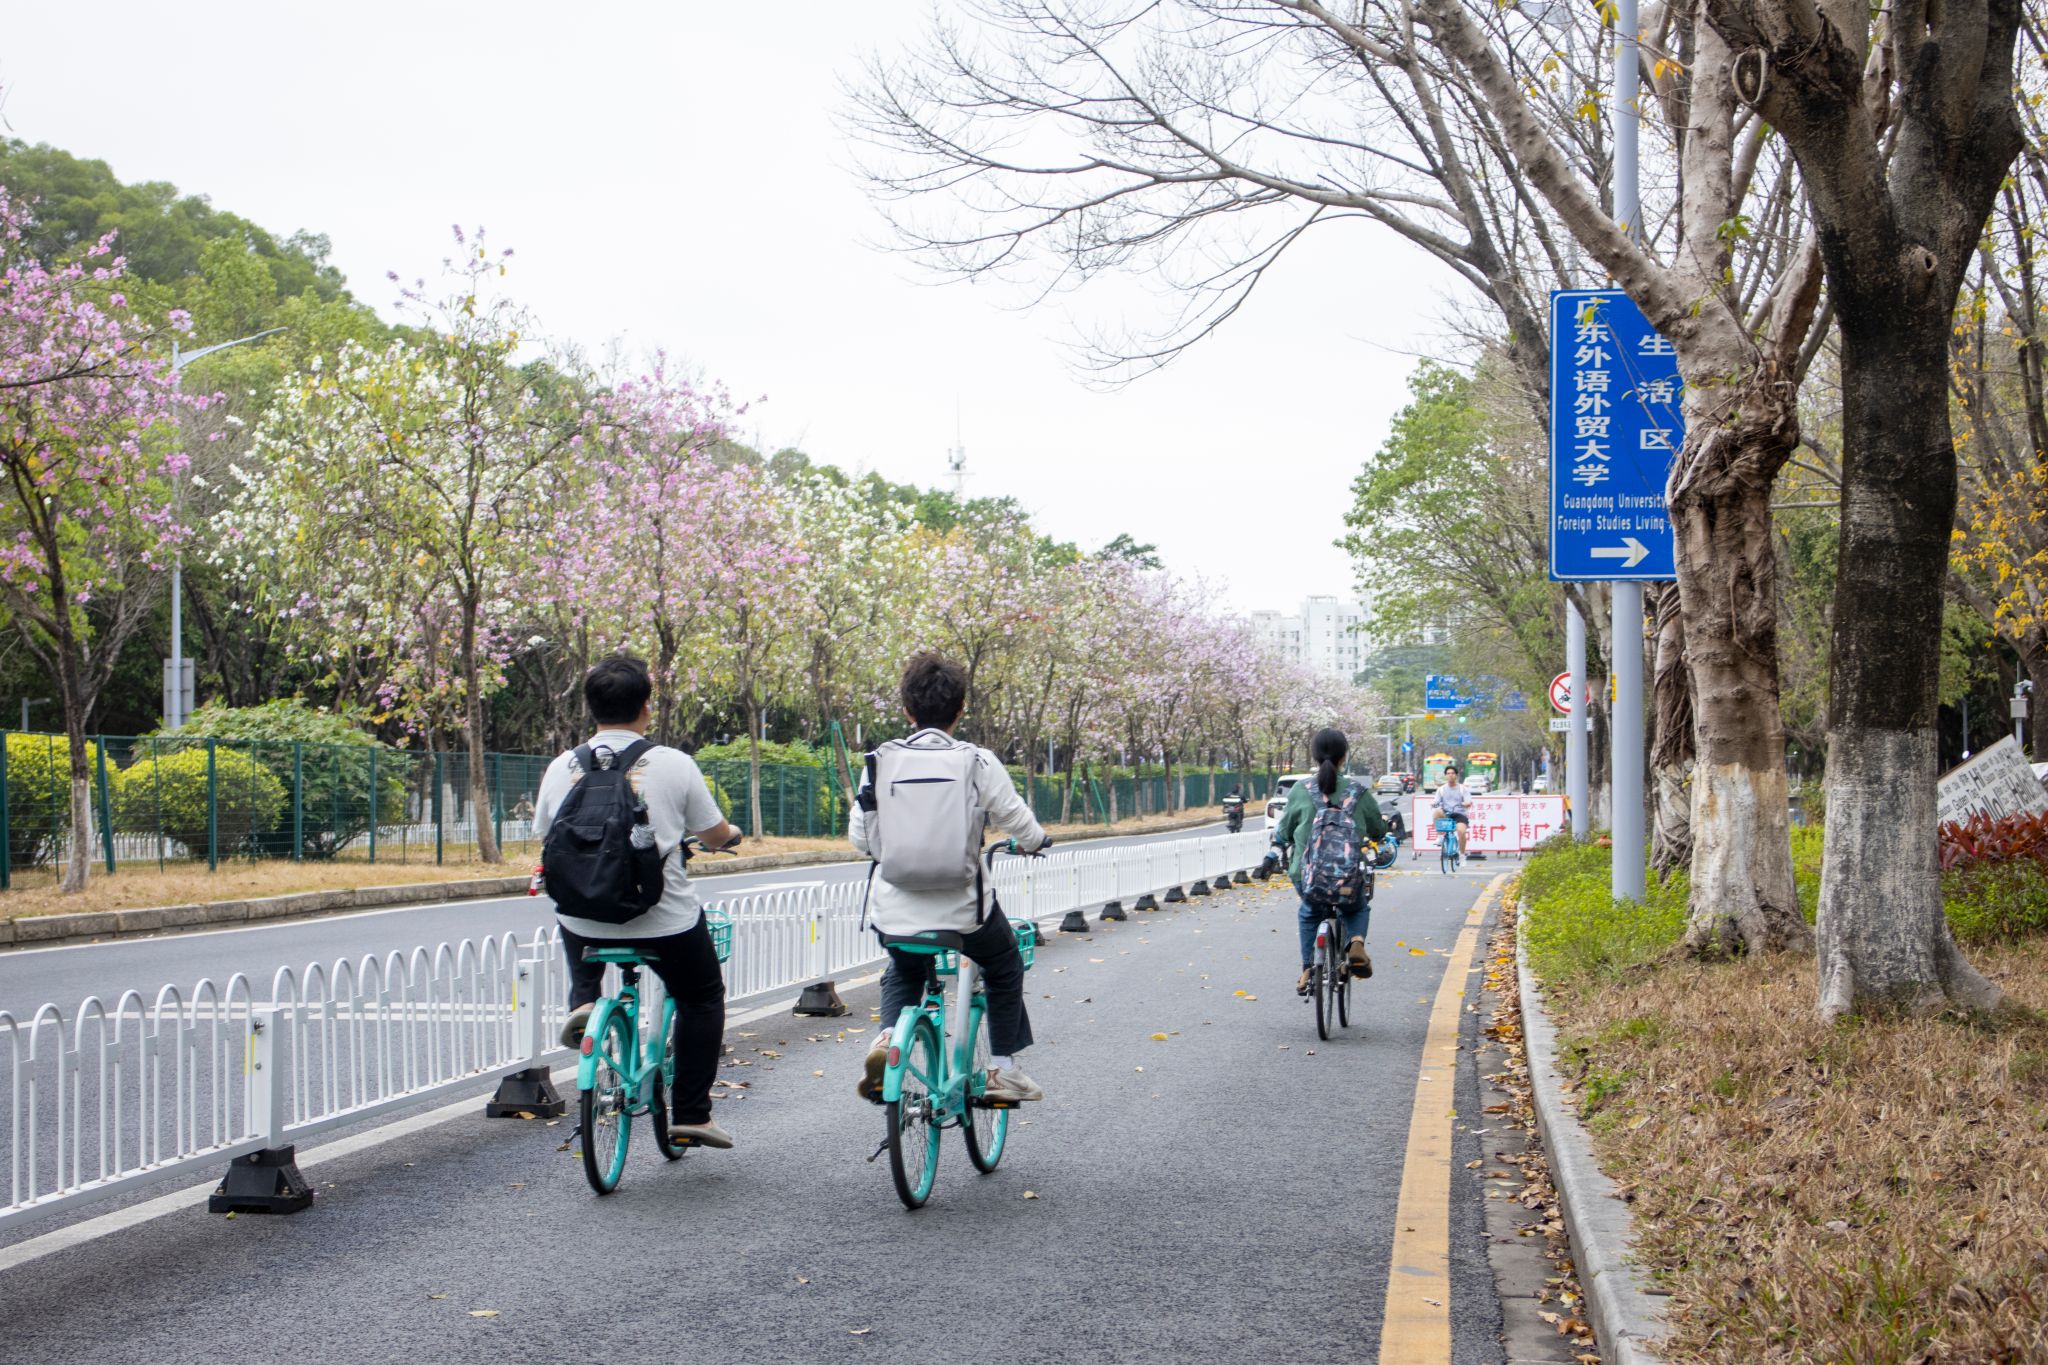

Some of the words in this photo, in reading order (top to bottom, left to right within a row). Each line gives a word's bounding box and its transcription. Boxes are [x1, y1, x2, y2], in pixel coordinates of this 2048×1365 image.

[1572, 296, 1612, 487] 广东外语外贸大学
[1637, 333, 1677, 450] 生活区
[1557, 515, 1592, 535] Foreign
[1596, 515, 1632, 531] Studies
[1635, 515, 1664, 535] Living
[1563, 493, 1614, 514] Guangdong
[1618, 493, 1666, 512] University
